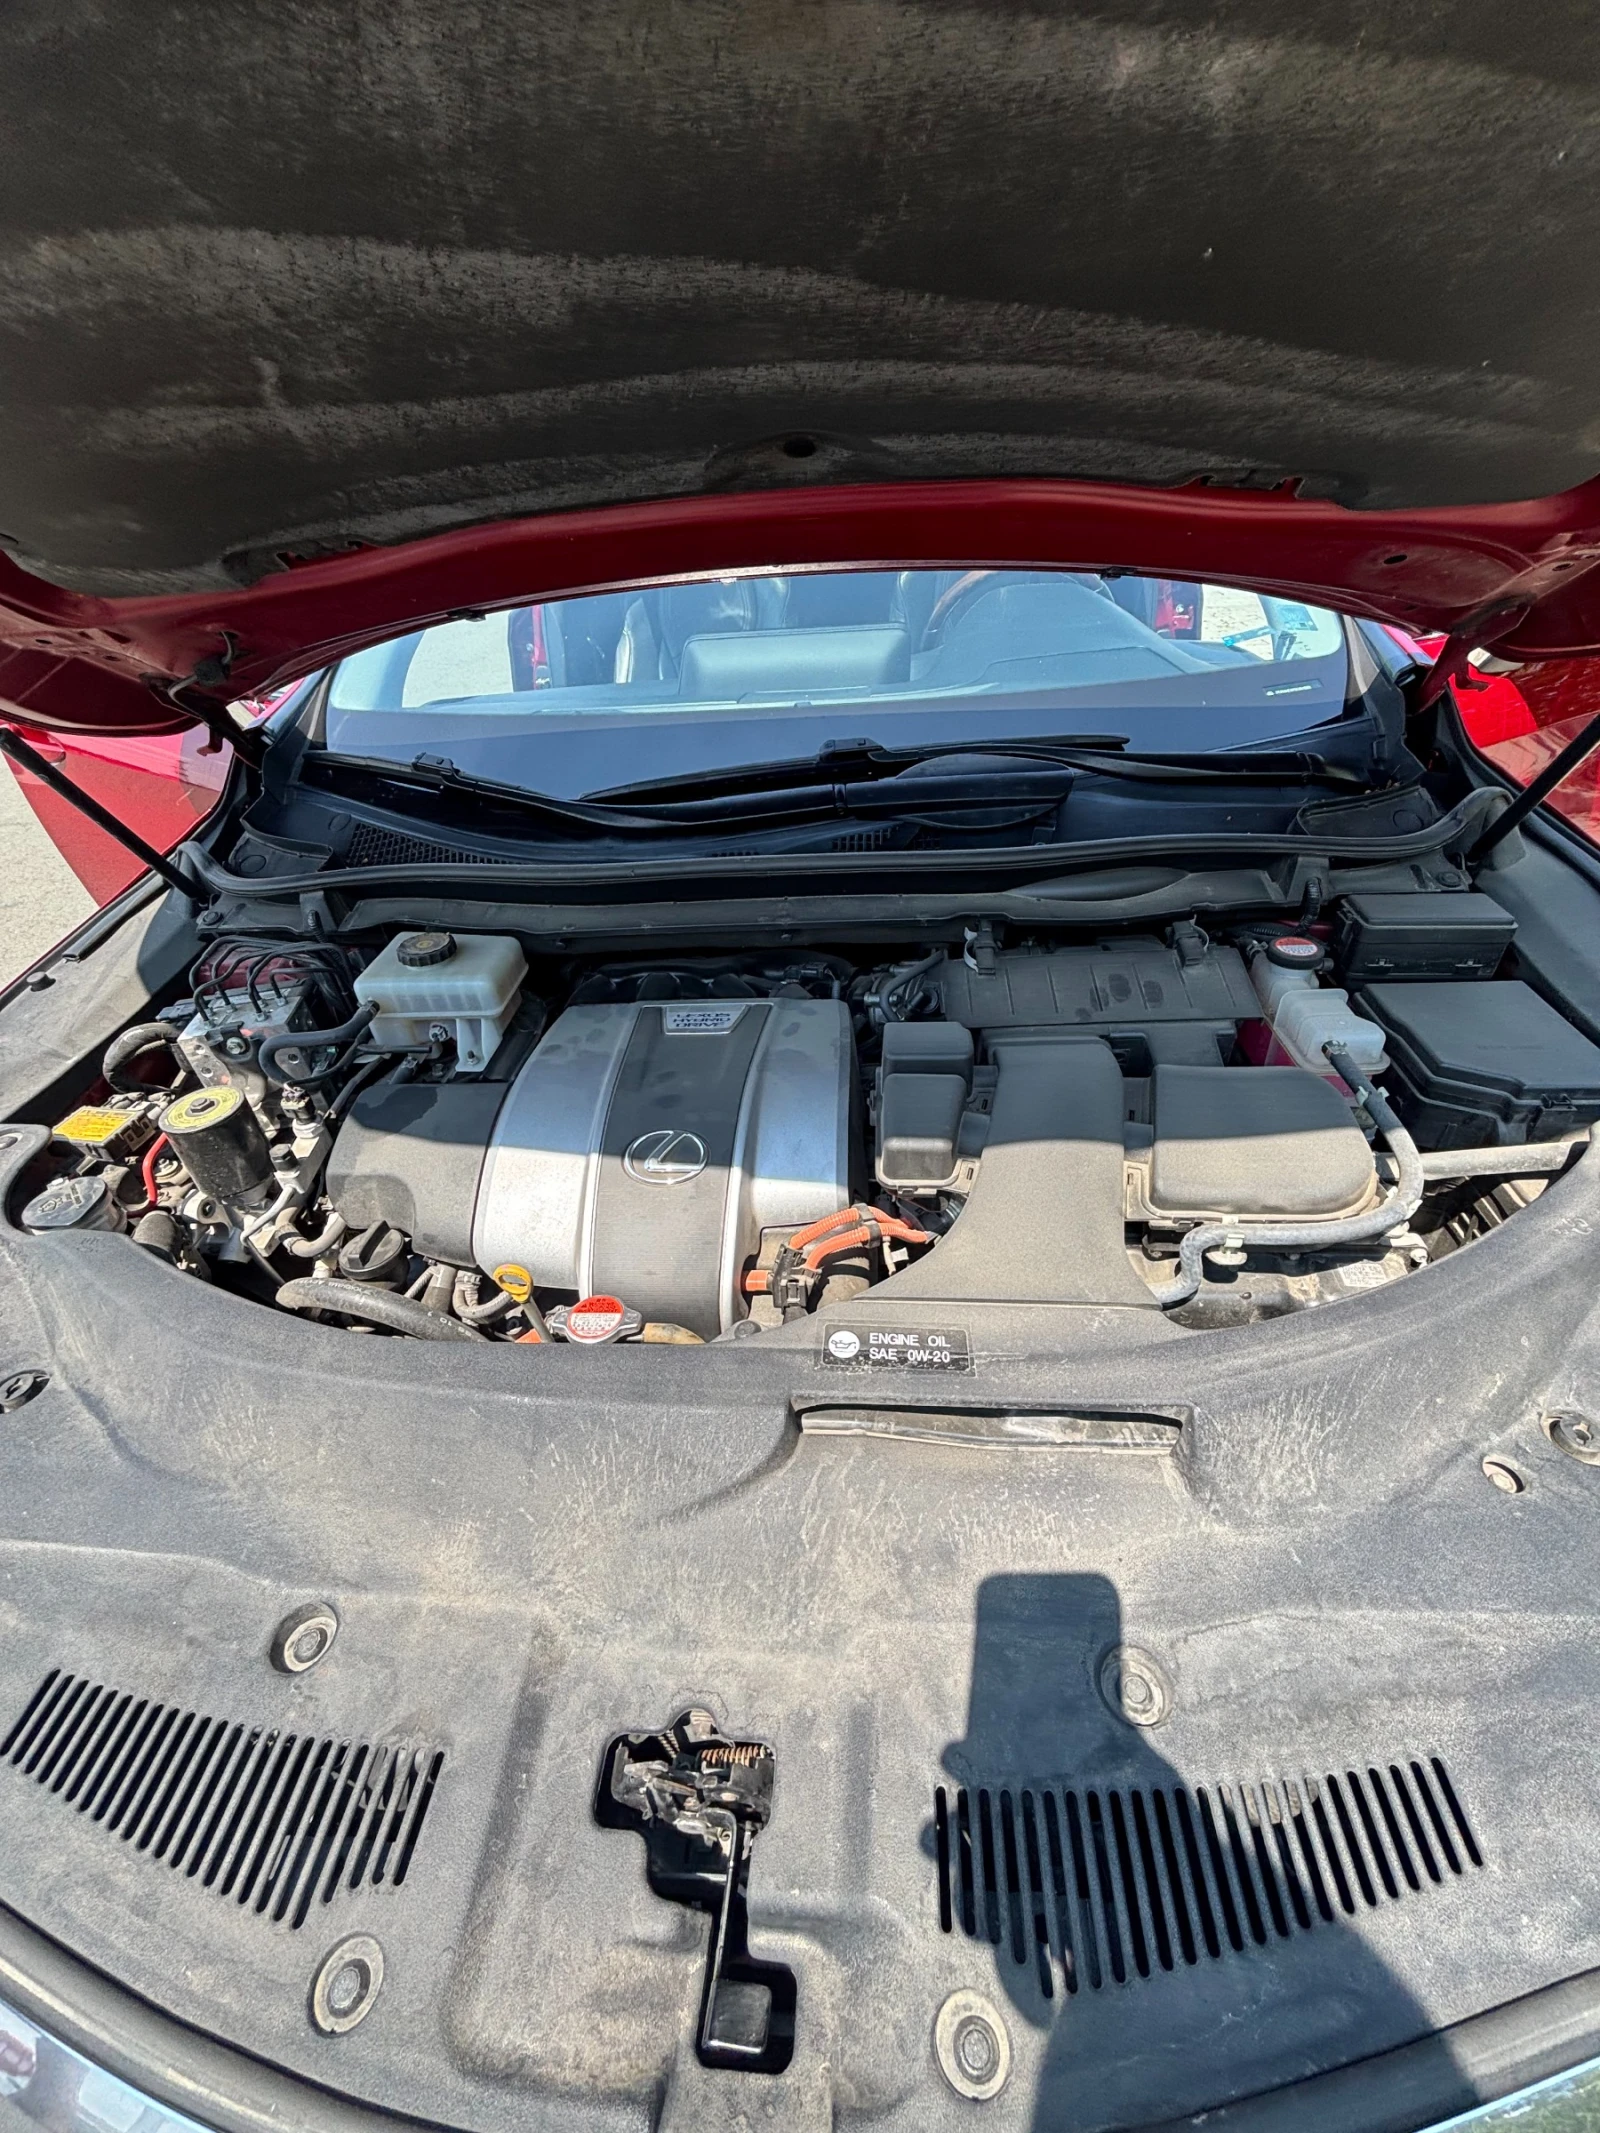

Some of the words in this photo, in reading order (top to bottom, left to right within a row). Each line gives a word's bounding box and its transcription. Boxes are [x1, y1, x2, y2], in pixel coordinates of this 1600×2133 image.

[869, 1332, 920, 1346] ENGINE
[927, 1335, 951, 1347] OIL
[869, 1347, 898, 1360] SAE
[907, 1349, 951, 1363] 0W-20
